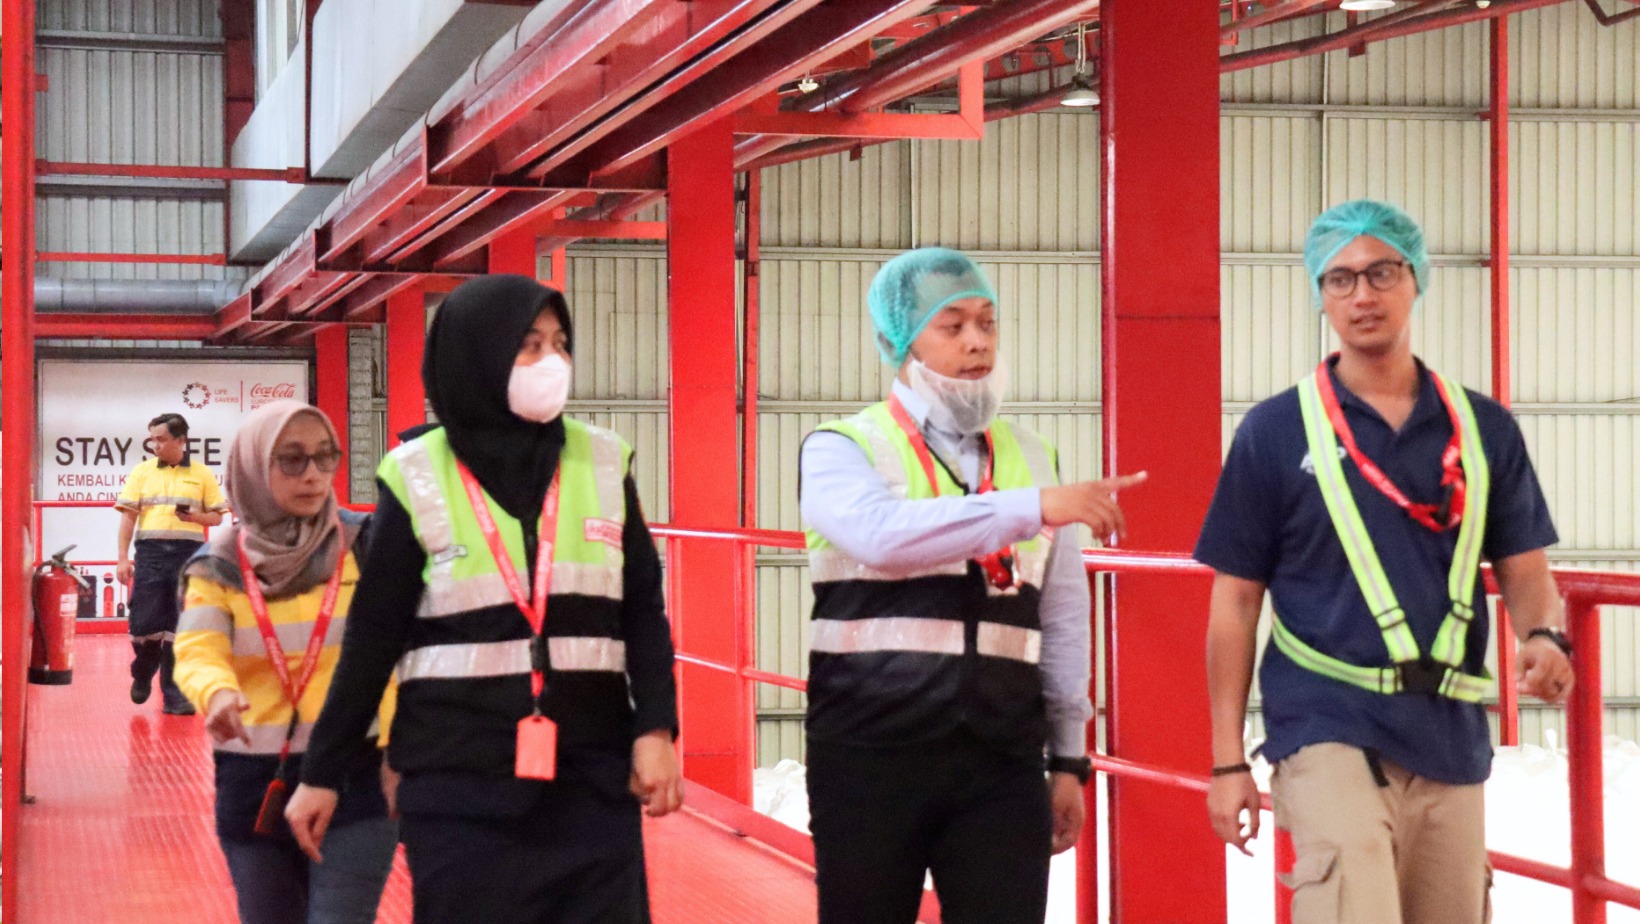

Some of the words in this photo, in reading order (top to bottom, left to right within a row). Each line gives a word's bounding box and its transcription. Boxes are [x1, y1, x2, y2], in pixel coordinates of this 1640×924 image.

[55, 437, 133, 466] STAY
[143, 437, 222, 466] SFE
[57, 474, 115, 486] KEMBALI
[58, 491, 93, 501] ANDA
